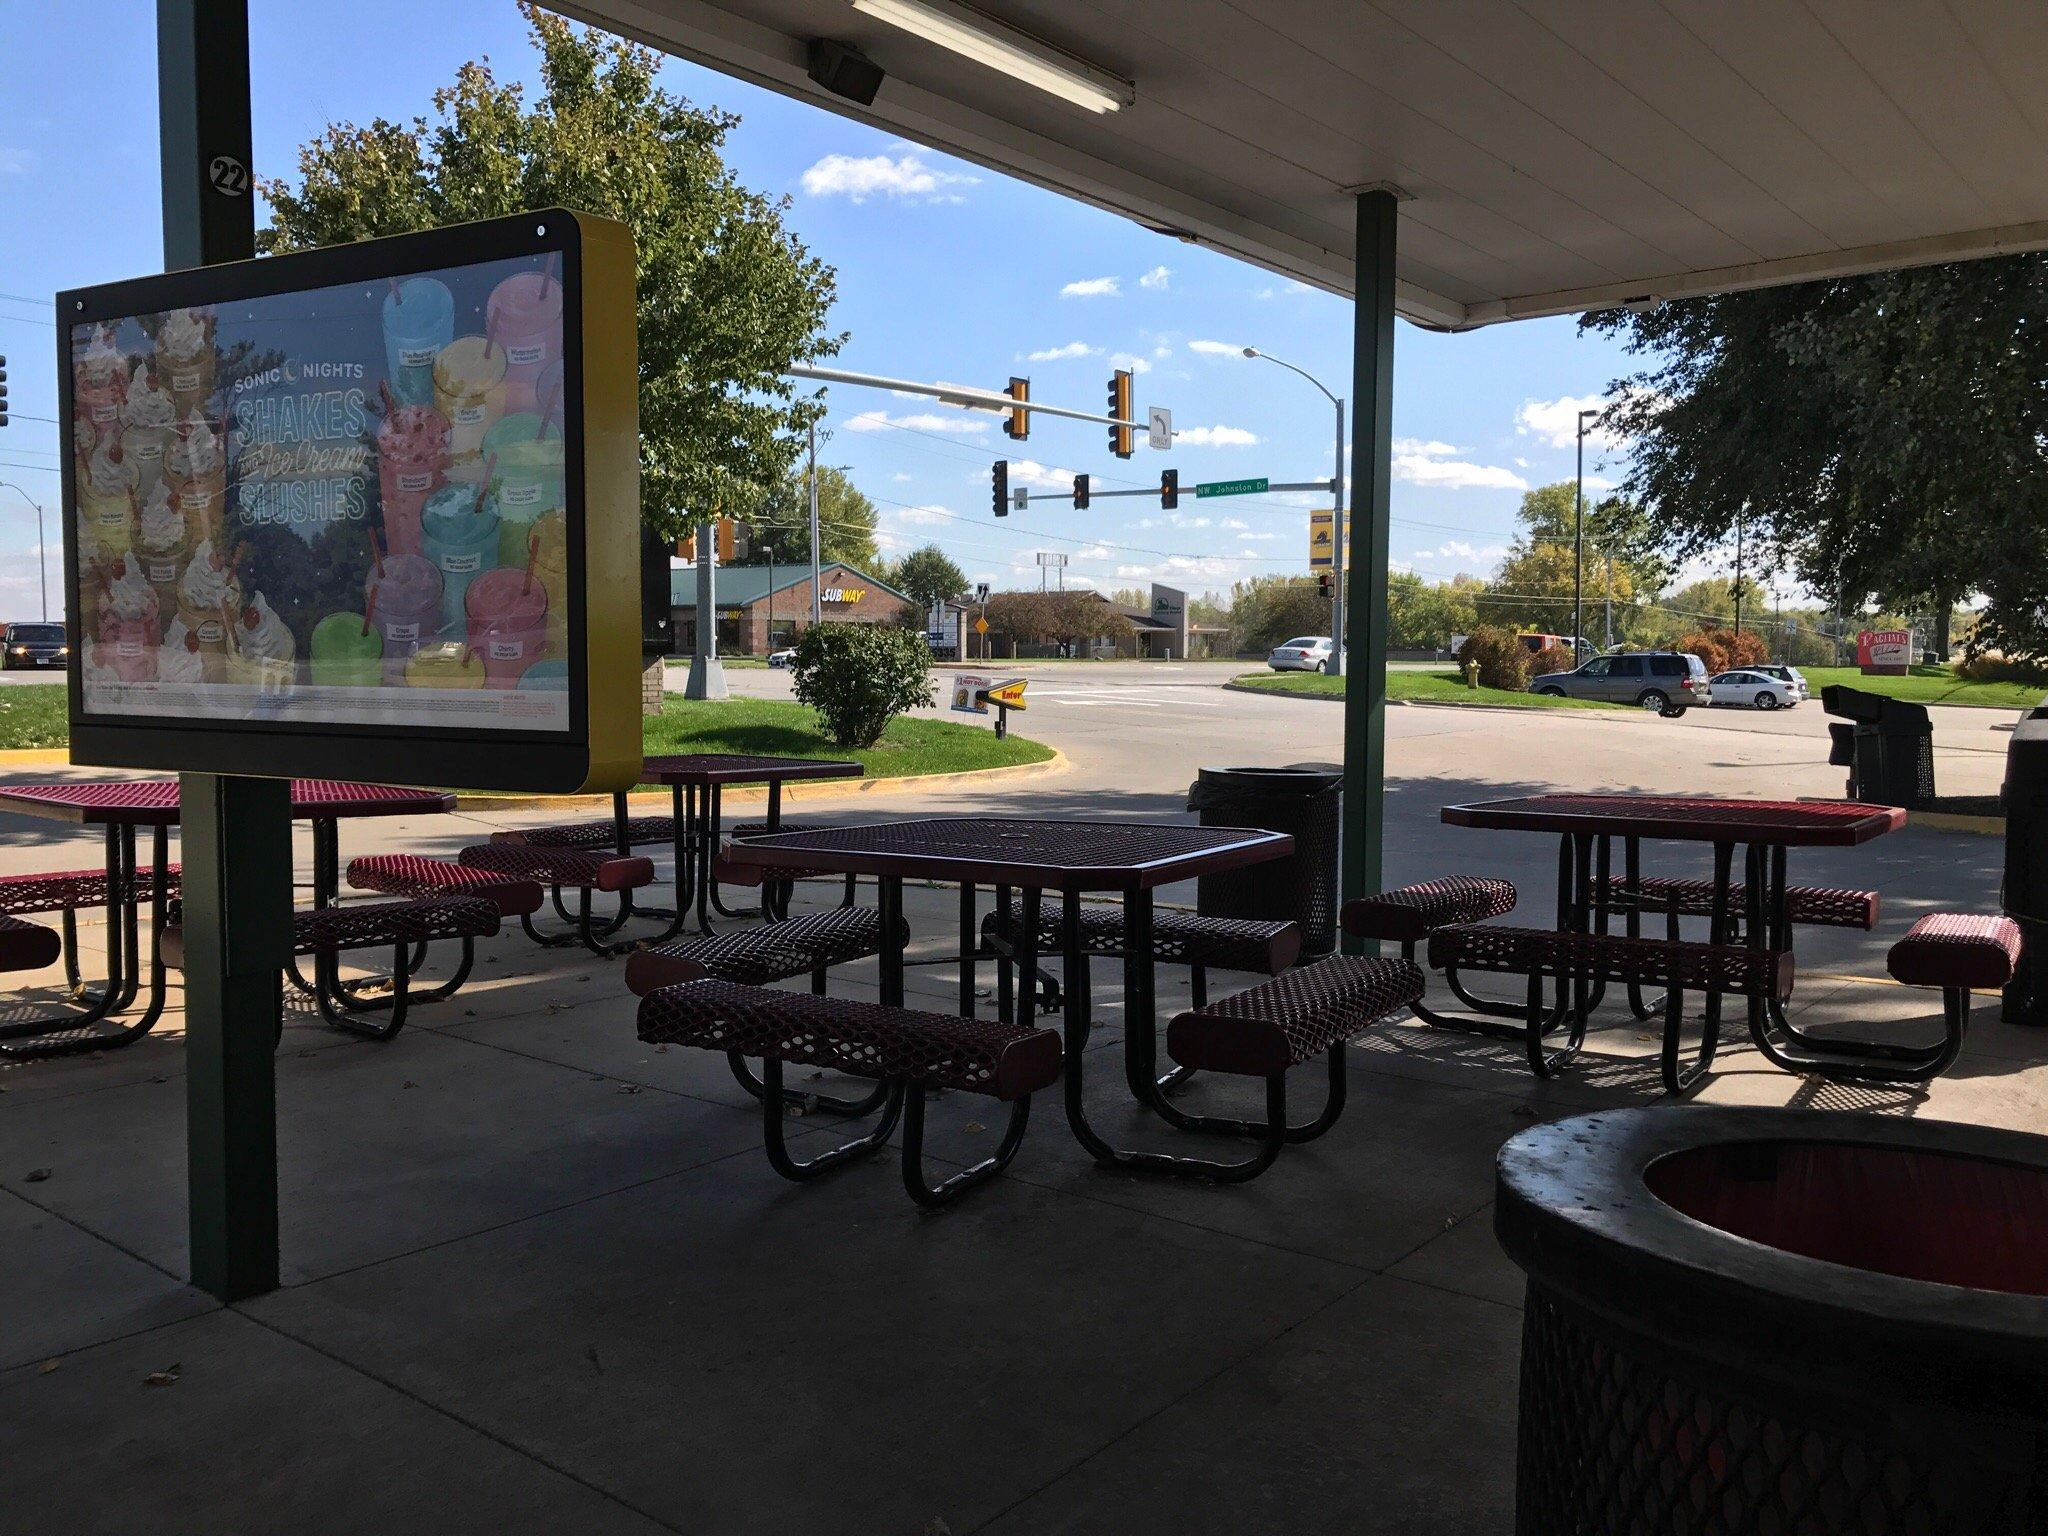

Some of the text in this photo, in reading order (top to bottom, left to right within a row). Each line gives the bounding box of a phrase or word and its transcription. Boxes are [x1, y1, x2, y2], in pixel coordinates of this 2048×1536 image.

[214, 160, 245, 192] 22
[234, 362, 364, 394] SONIC NIGHTS
[235, 388, 366, 448] SHAKES
[1152, 435, 1168, 446] ONLY
[262, 442, 294, 478] Ice
[295, 440, 367, 475] Cream
[1198, 481, 1267, 495] NW Johnston Dr
[238, 476, 366, 526] SLUSHES
[821, 588, 866, 603] SUBWAY
[716, 610, 744, 620] SUBWAY
[1002, 690, 1021, 700] Enter
